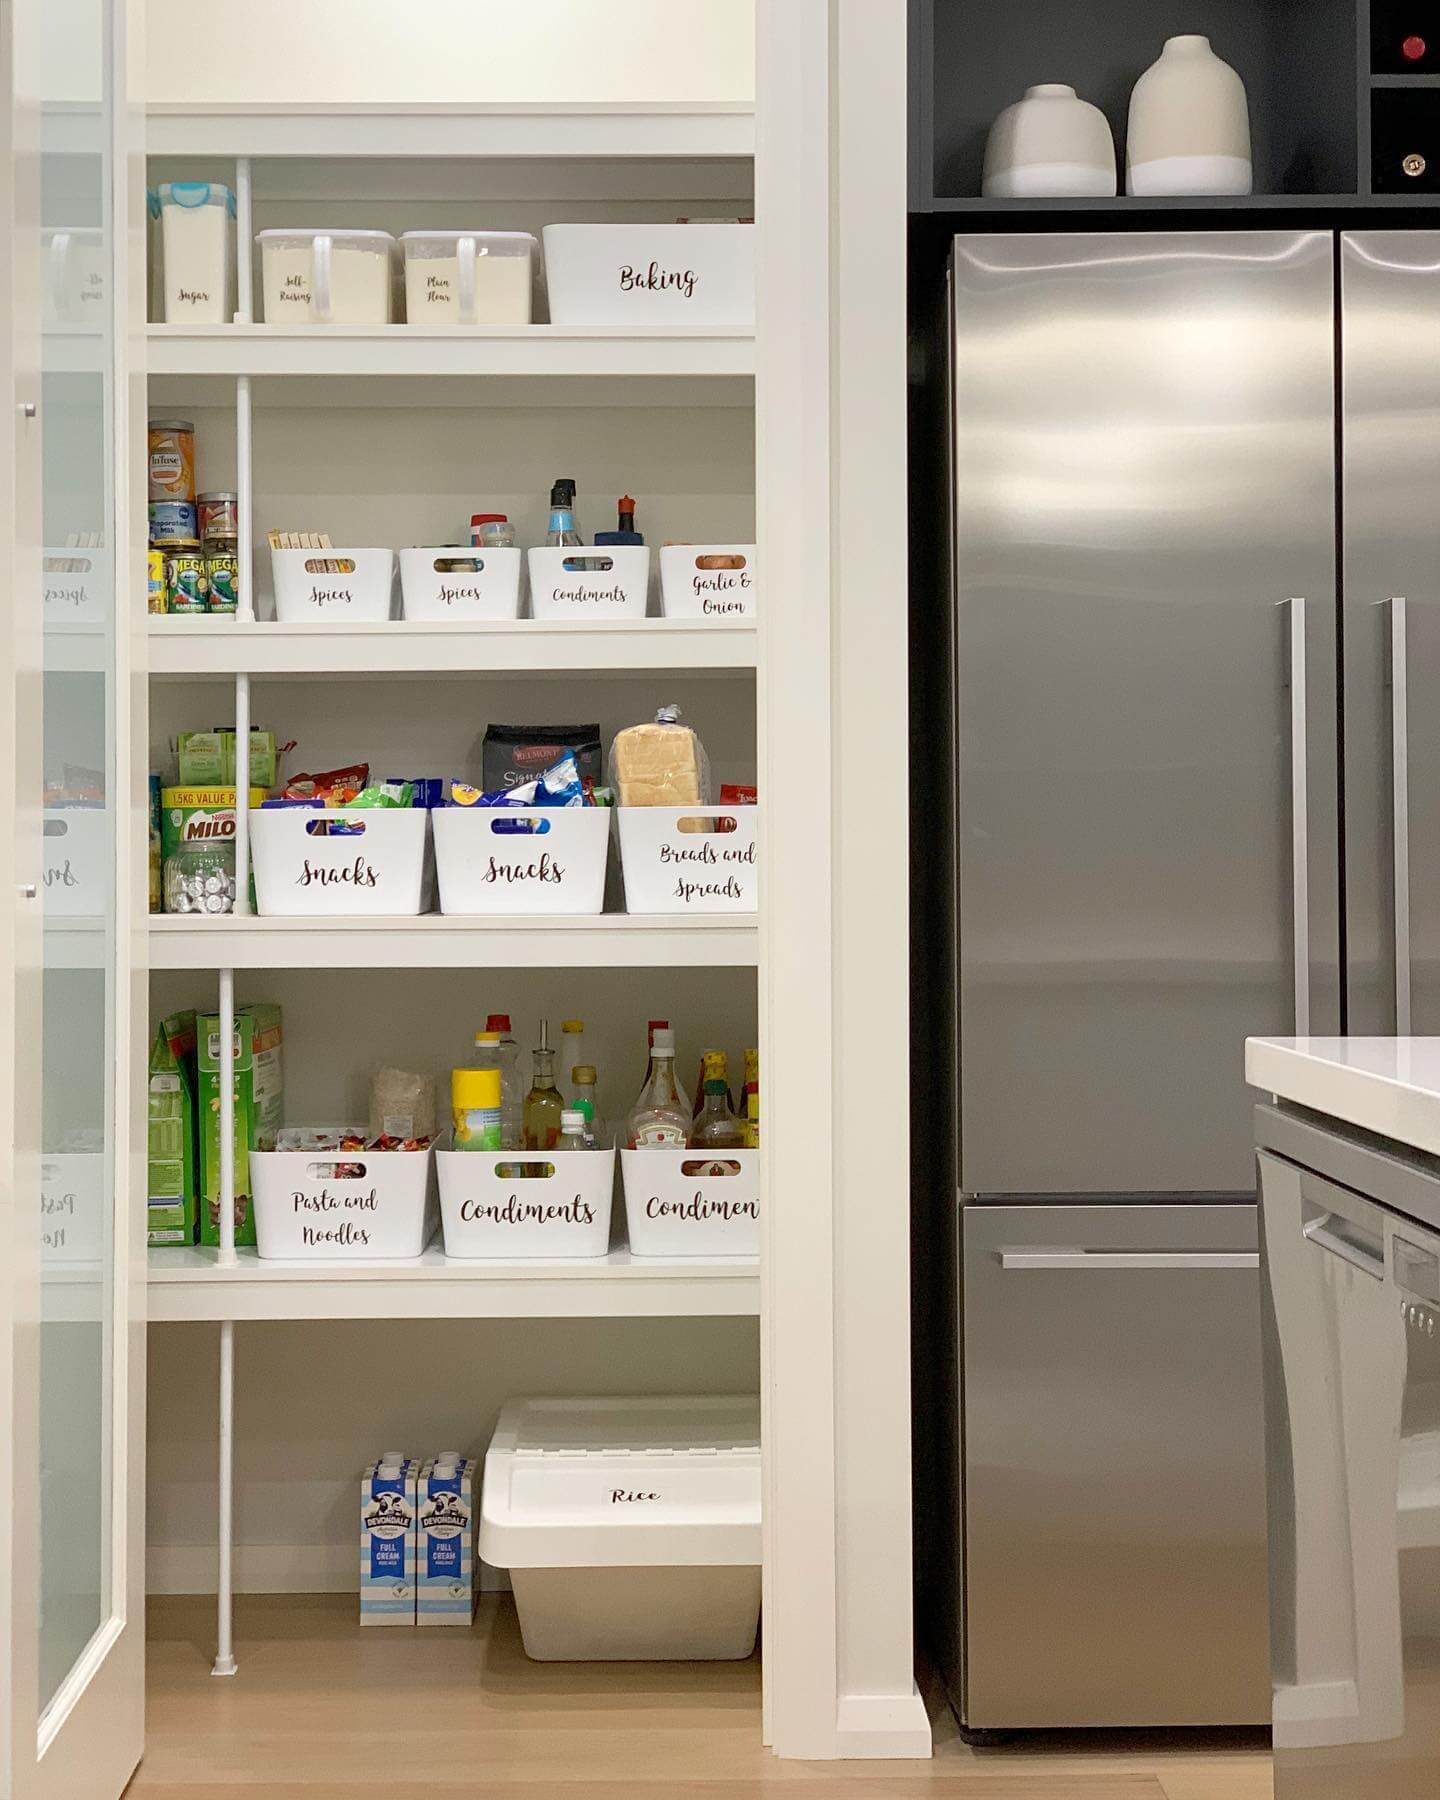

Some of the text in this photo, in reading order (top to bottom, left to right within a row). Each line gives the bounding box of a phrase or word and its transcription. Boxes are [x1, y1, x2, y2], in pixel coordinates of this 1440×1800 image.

[427, 276, 448, 287] Plain
[619, 262, 698, 298] Baking
[178, 289, 208, 304] Sugar
[280, 291, 311, 304] Raising
[428, 291, 450, 302] Flour
[176, 560, 205, 573] MEGA
[208, 559, 238, 573] MEGA
[693, 572, 752, 595] Garlic &
[309, 586, 353, 606] Spices
[437, 585, 481, 605] Spices
[553, 586, 627, 602] Condiments
[703, 600, 743, 614] Onion
[197, 793, 225, 804] VALUE
[187, 820, 236, 840] MILO
[661, 842, 756, 864] Breads and
[296, 857, 380, 887] Snacks
[481, 853, 565, 883] Snacks
[675, 876, 743, 902] Spreads
[291, 1189, 378, 1212] Pasta and
[646, 1191, 759, 1220] Condimen
[461, 1194, 596, 1224] Condiments
[304, 1223, 370, 1245] Noodles
[609, 1488, 660, 1503] Rice
[367, 1515, 410, 1527] DEVONDALE
[423, 1515, 466, 1527] DEVONDALE
[380, 1543, 396, 1552] FULL
[436, 1543, 452, 1552] FULL
[376, 1552, 400, 1561] CREAM
[432, 1552, 456, 1561] CREAM
